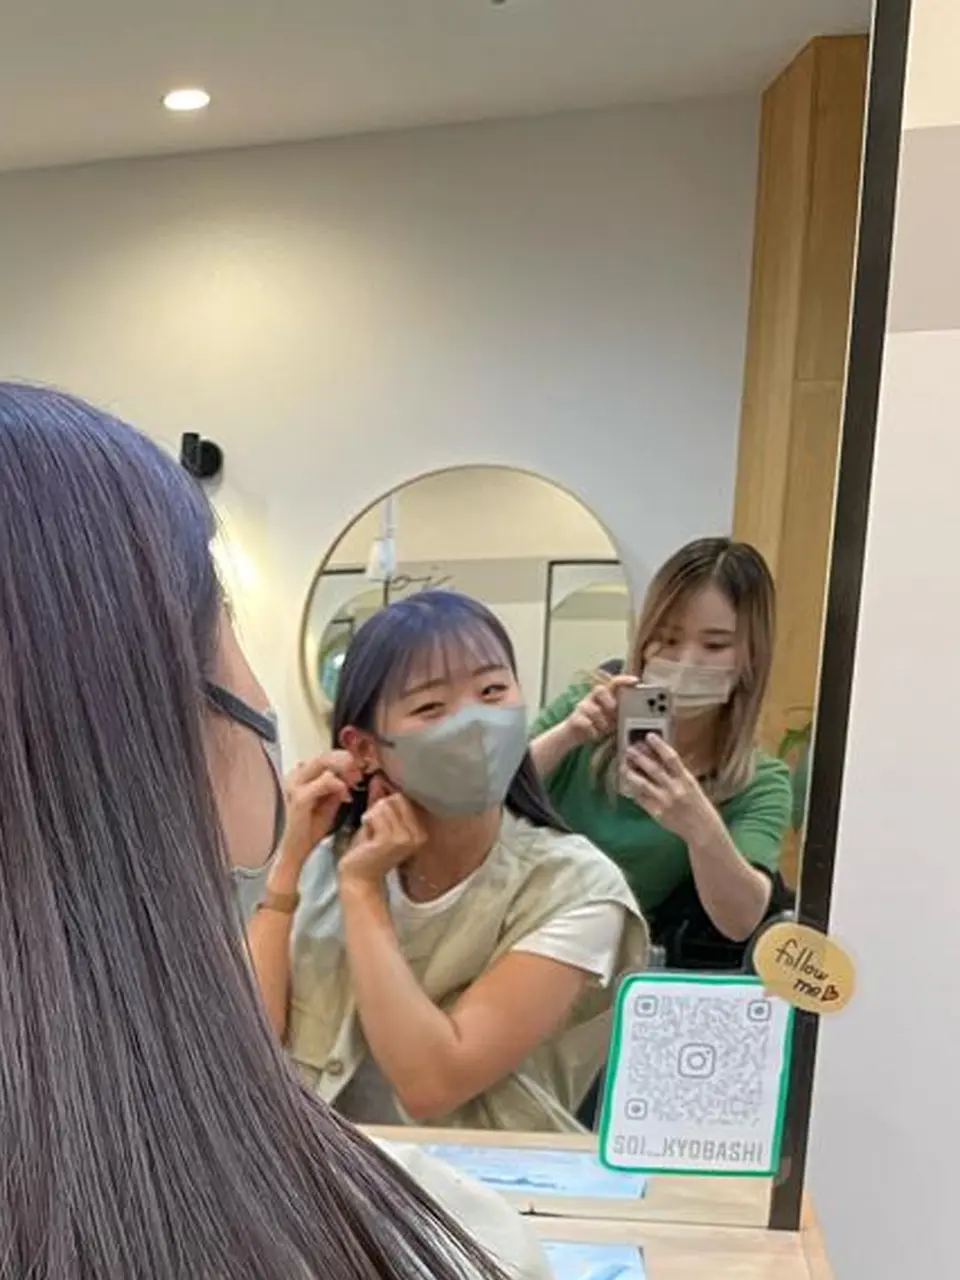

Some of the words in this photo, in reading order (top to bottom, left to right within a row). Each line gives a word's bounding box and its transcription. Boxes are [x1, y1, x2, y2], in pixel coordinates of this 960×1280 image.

[775, 938, 829, 980] follow
[793, 979, 822, 997] me
[613, 1134, 764, 1163] SOI_KYOBASHI
